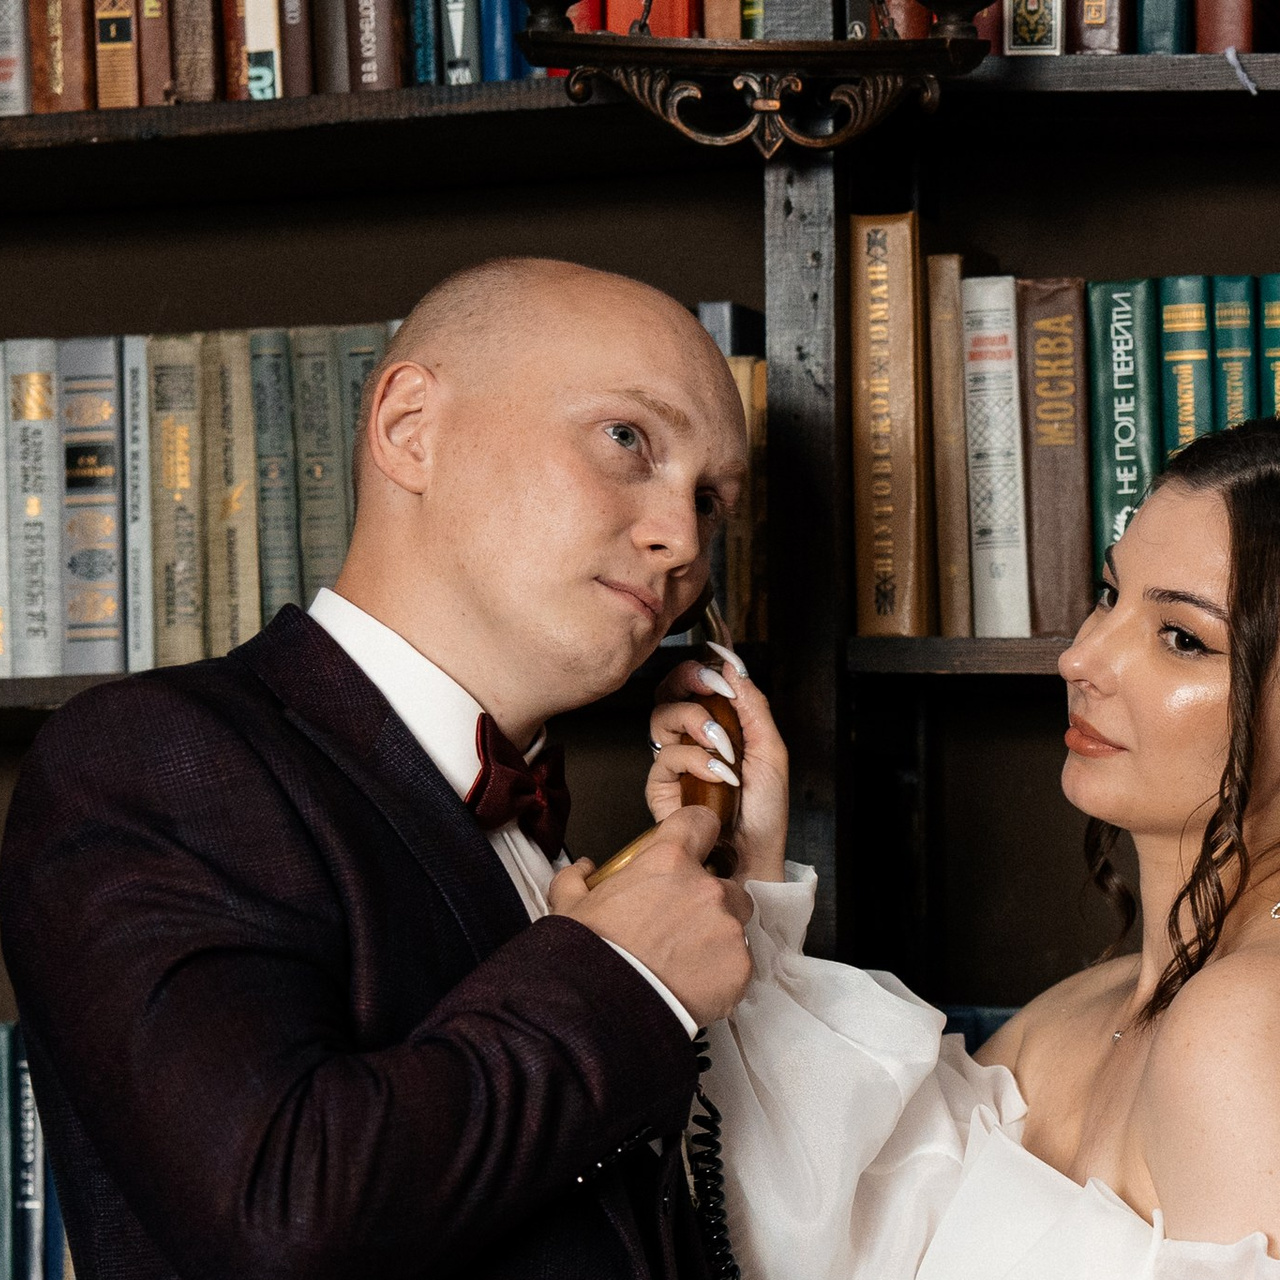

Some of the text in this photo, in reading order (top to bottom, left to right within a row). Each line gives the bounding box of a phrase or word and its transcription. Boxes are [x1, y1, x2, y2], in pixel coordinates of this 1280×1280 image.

[867, 265, 890, 358] РОМАН
[1110, 292, 1135, 389] ПЕРЕЙТИ
[1033, 314, 1077, 447] МОСКВА
[1113, 396, 1136, 460] ПОЛЕ
[1116, 466, 1138, 494] НЕ
